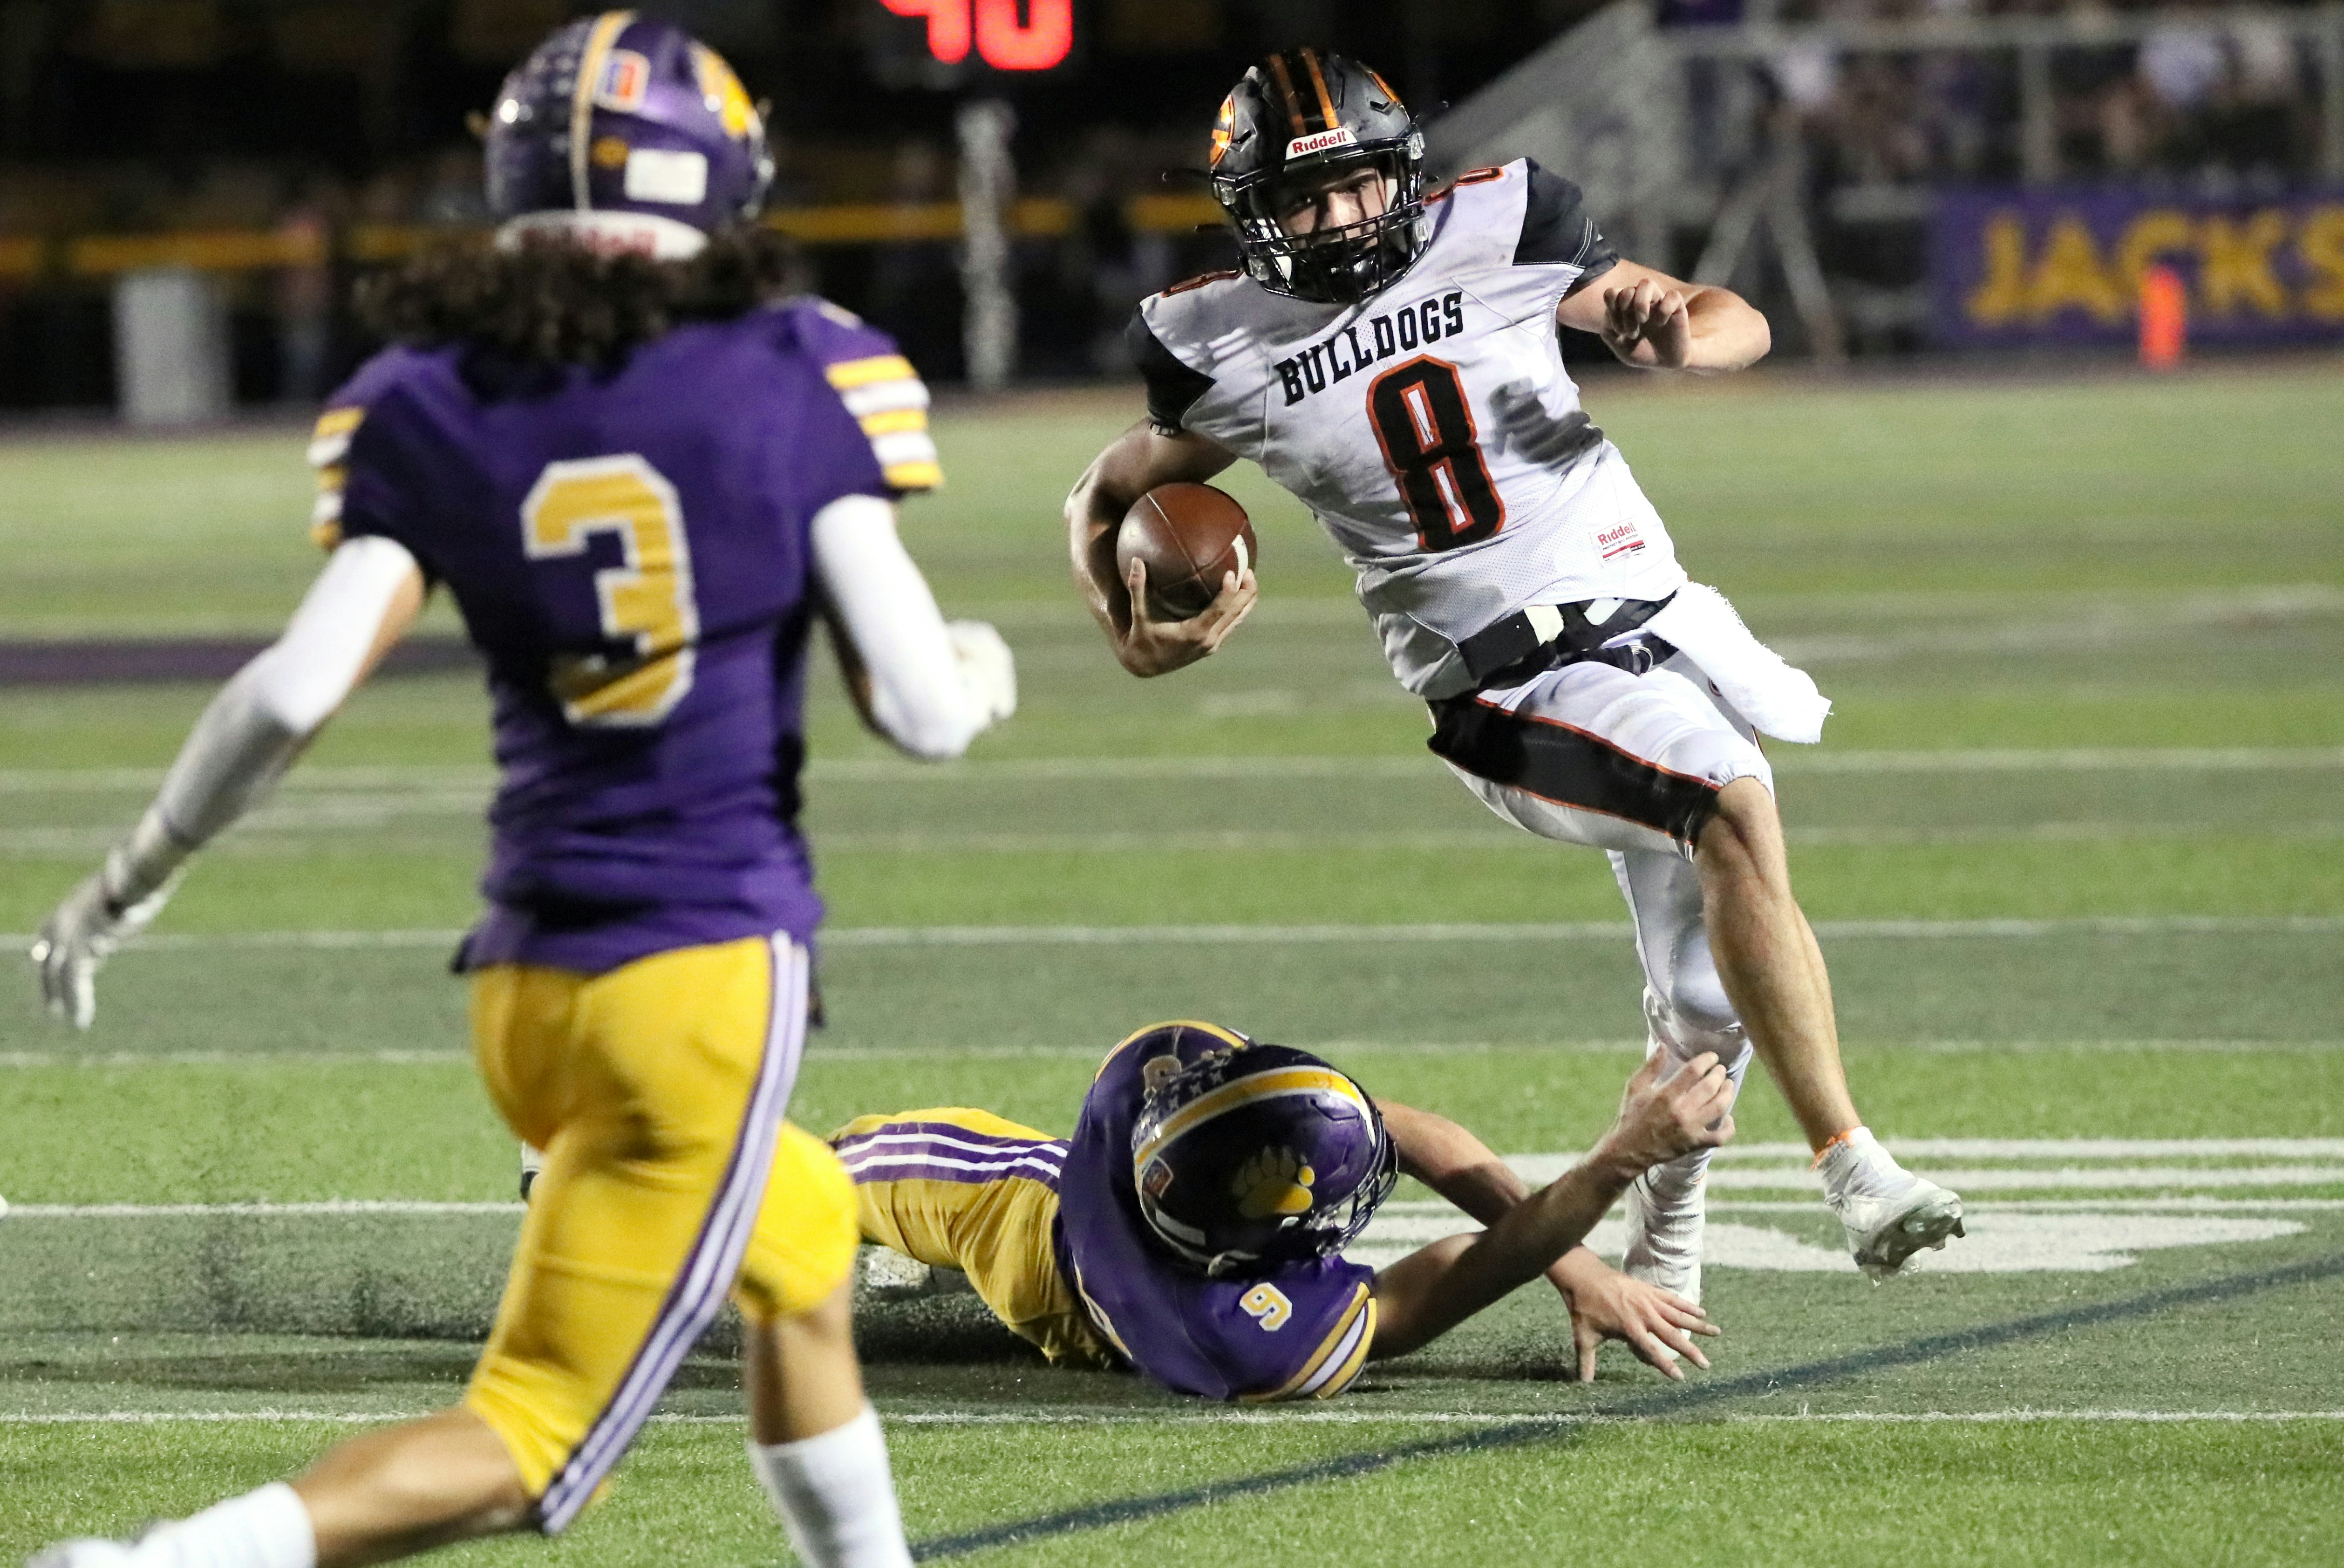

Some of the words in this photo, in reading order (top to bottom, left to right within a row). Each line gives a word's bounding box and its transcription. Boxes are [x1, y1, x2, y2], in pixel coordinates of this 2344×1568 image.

[1292, 131, 1347, 154] Riddell
[1273, 292, 1464, 407] BULLDOGS
[1366, 353, 1506, 552] 8
[1597, 522, 1636, 545] Riddell
[519, 453, 699, 728] 3
[1239, 1282, 1293, 1332] 9
